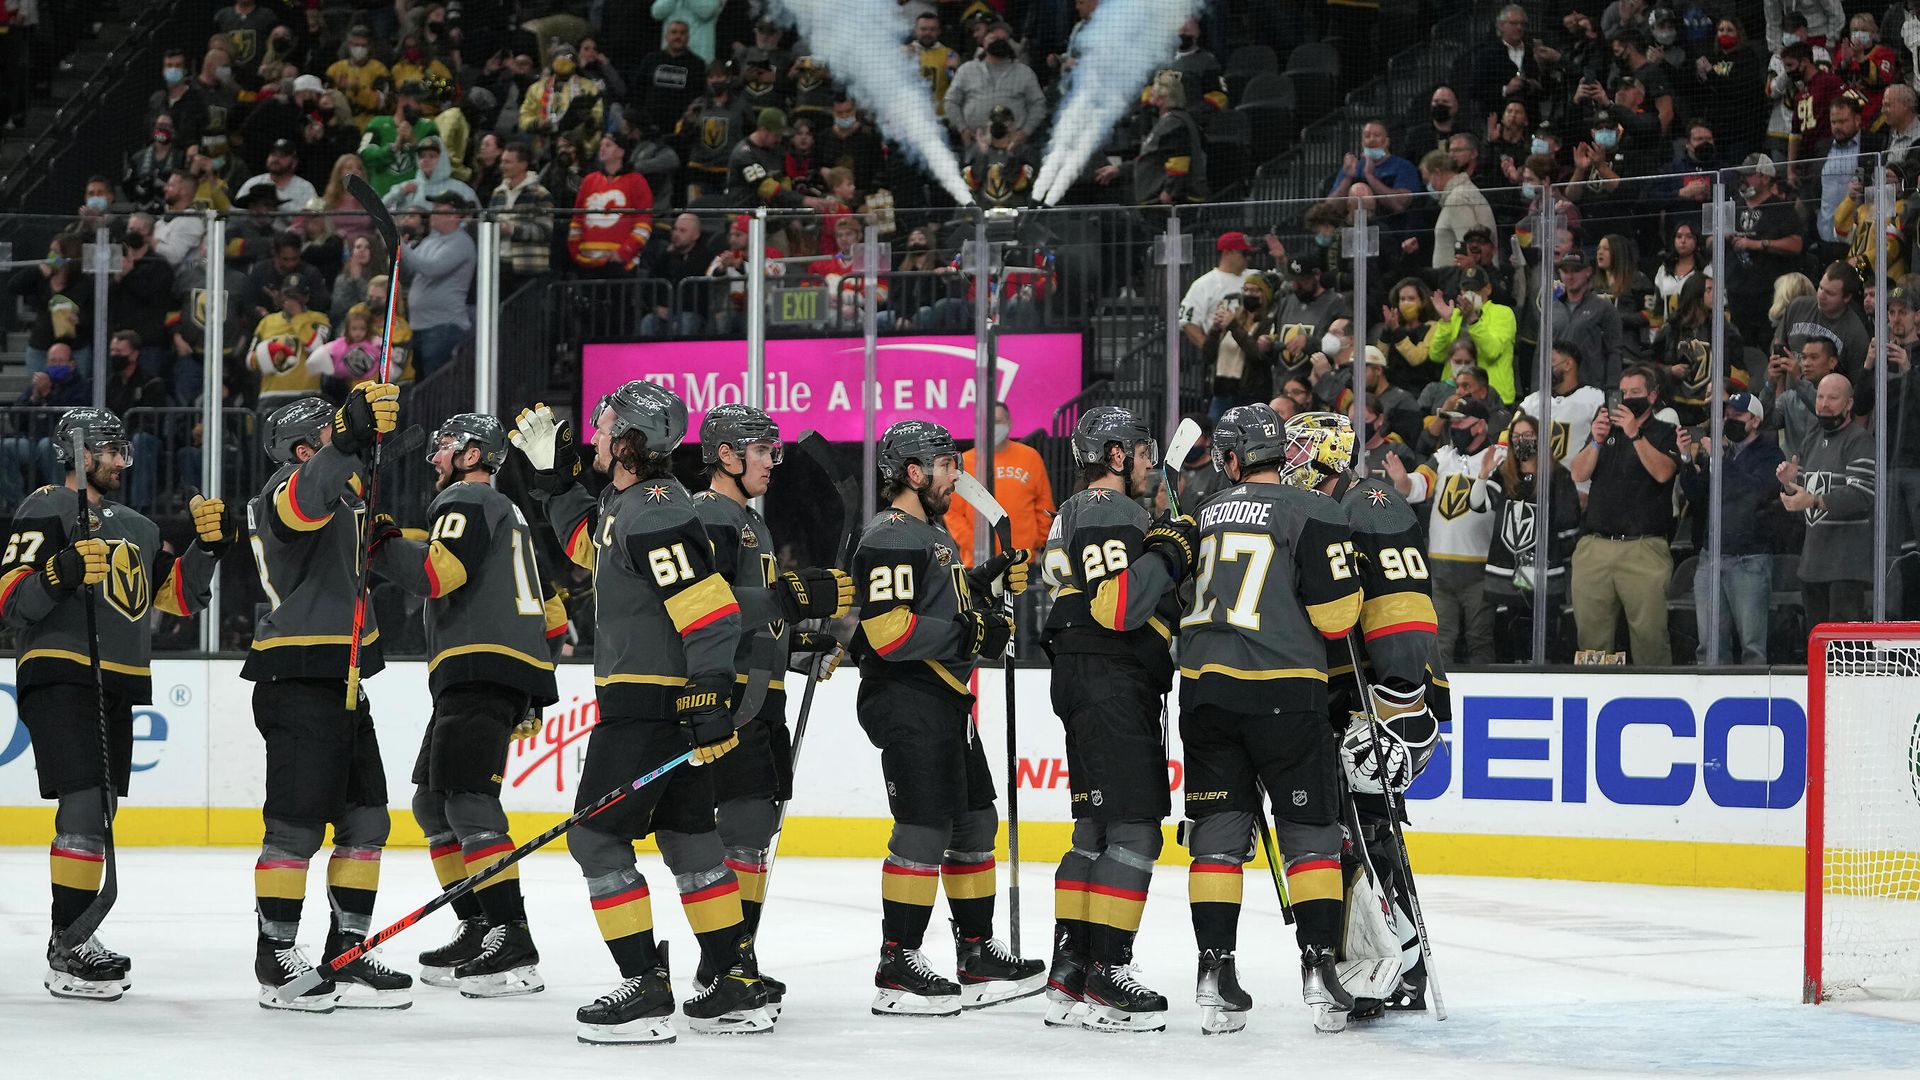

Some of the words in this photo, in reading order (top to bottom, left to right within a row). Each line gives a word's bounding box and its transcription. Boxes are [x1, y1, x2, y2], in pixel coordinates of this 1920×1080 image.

[1796, 95, 1818, 133] 91
[783, 291, 817, 321] EXIT
[683, 372, 811, 412] Moile
[828, 379, 978, 411] ARENA
[1262, 423, 1277, 438] 27
[429, 512, 468, 542] 10
[1200, 501, 1272, 533] THEODORE
[1, 531, 45, 566] 67
[648, 542, 696, 588] 61
[1082, 539, 1129, 583] 26
[1379, 547, 1430, 581] 90
[511, 528, 546, 616] 1
[869, 564, 914, 602] 20
[1180, 531, 1276, 632] 27
